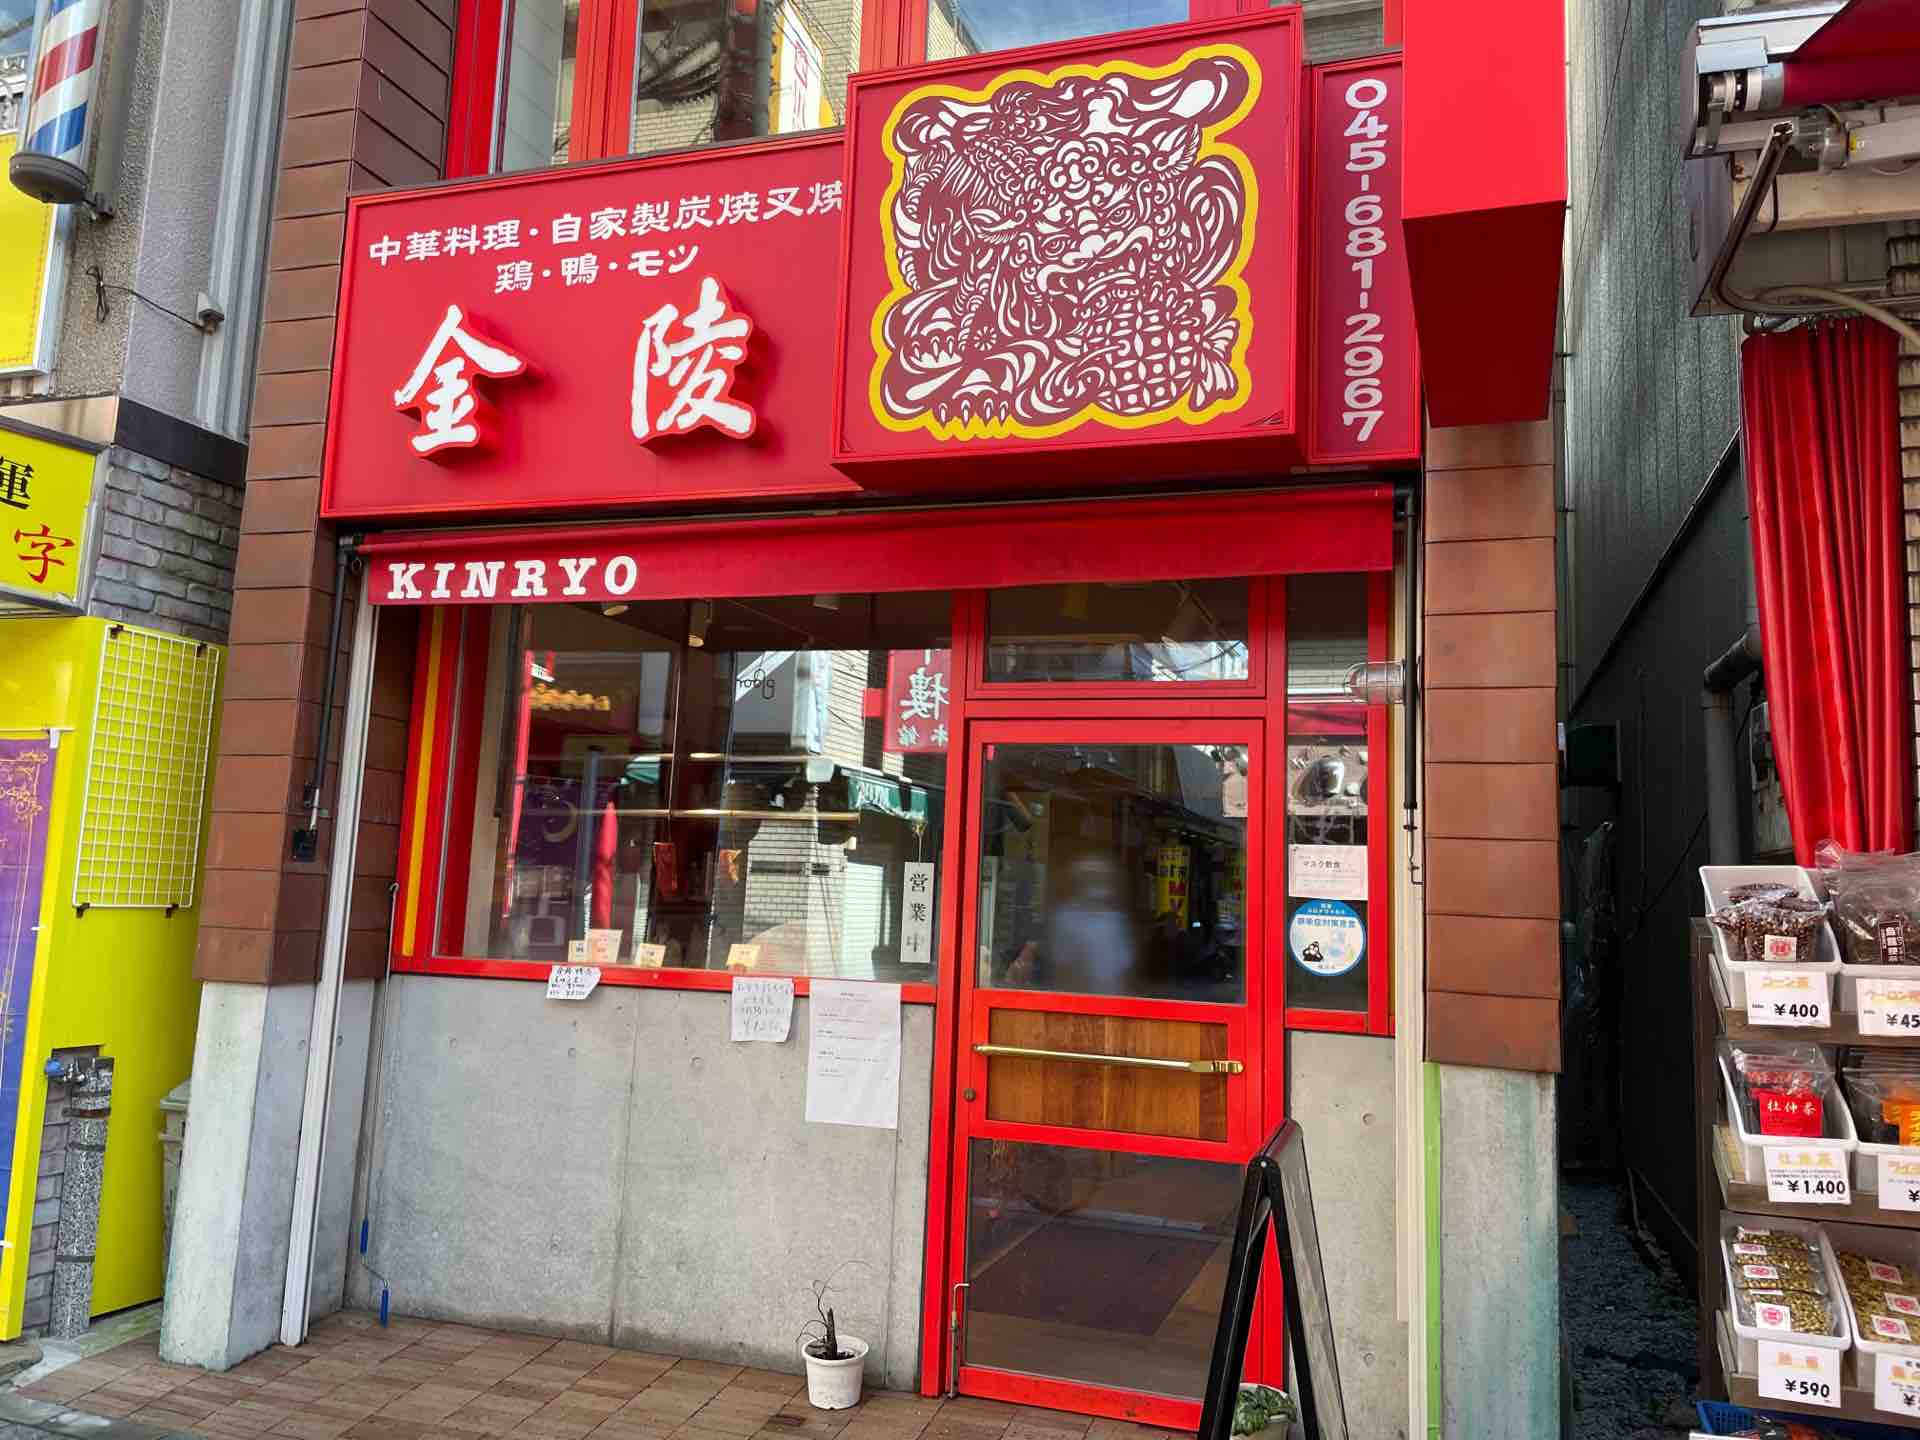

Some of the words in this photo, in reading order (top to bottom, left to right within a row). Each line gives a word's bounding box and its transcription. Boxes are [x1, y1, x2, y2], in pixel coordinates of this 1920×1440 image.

[1342, 78, 1389, 442] 045-681-2967
[394, 277, 756, 453] 金陵
[14, 523, 75, 584] 字
[387, 556, 638, 600] KINRYO
[906, 872, 928, 953] 営業中
[1774, 1004, 1819, 1018] ¥400
[1767, 1100, 1817, 1116] 杜仲茶
[1785, 1378, 1830, 1398] ¥590
